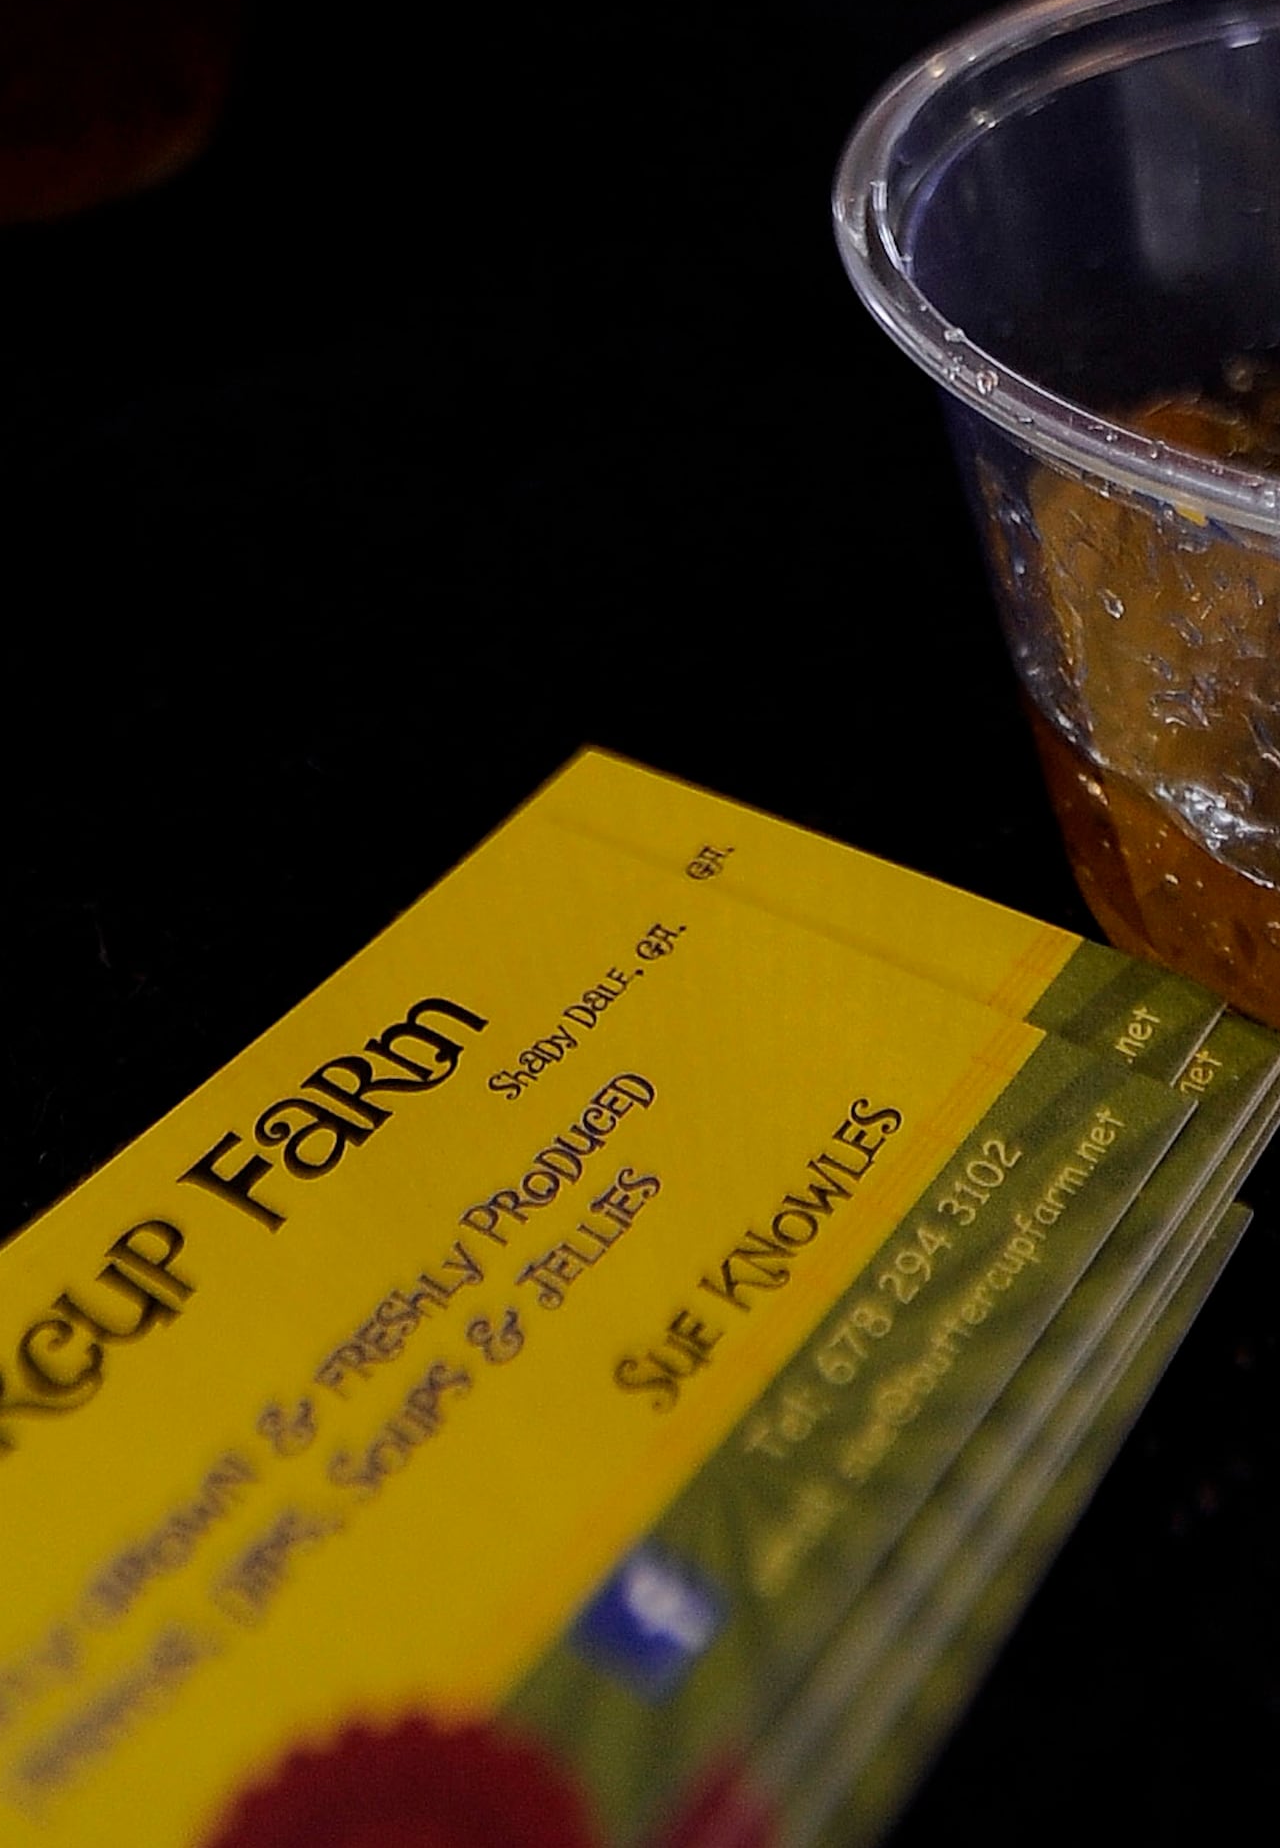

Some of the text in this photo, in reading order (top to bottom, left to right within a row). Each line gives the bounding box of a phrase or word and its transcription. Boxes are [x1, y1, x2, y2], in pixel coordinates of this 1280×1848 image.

[256, 1397, 317, 1457] &
[460, 1072, 657, 1246] PRODUCED
[465, 1306, 525, 1365] &
[515, 1168, 662, 1311] JELLIES
[697, 1097, 903, 1314] KNOWLES
[816, 1300, 893, 1385] 678
[879, 1225, 954, 1305] 294
[937, 1136, 1023, 1226] 3102
